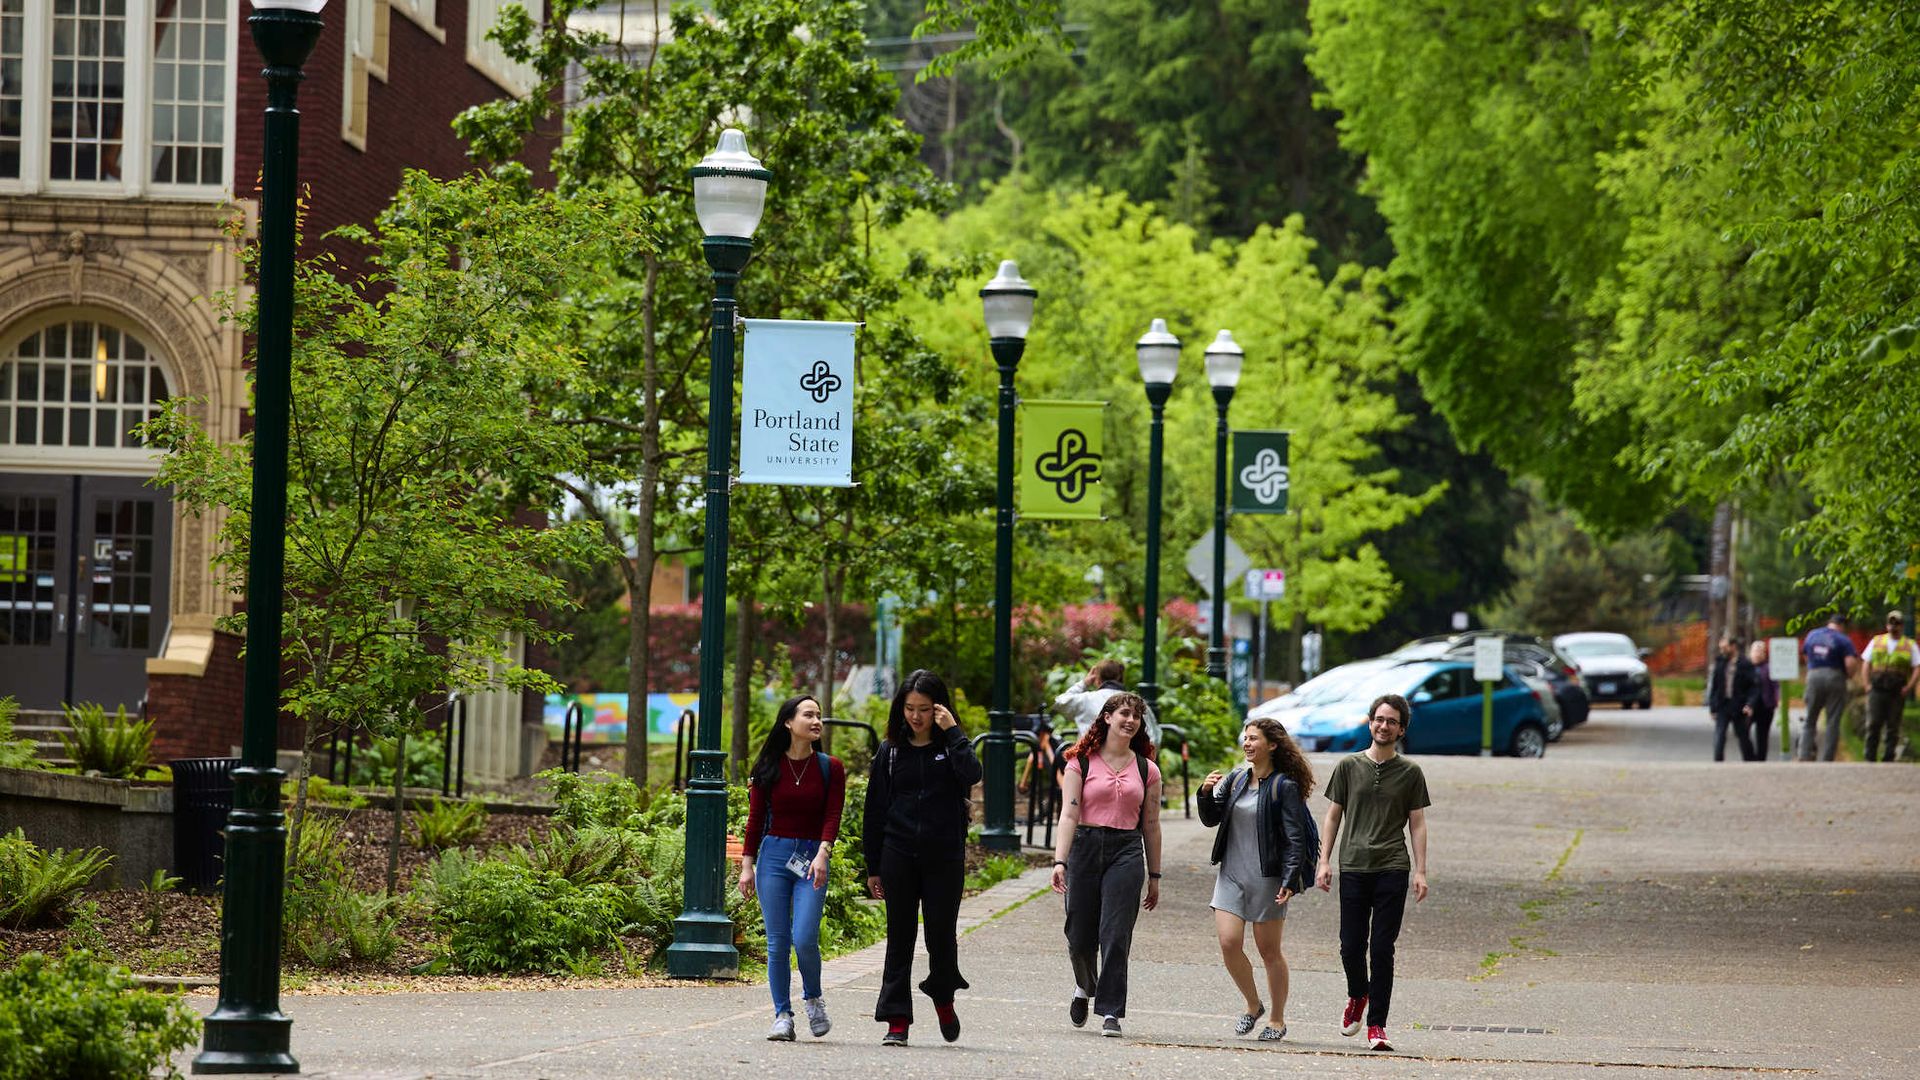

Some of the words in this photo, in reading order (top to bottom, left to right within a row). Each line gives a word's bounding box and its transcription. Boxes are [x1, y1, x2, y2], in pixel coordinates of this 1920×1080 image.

[754, 409, 840, 430] Portland
[789, 432, 840, 453] State
[767, 456, 838, 465] UNIVERSITY
